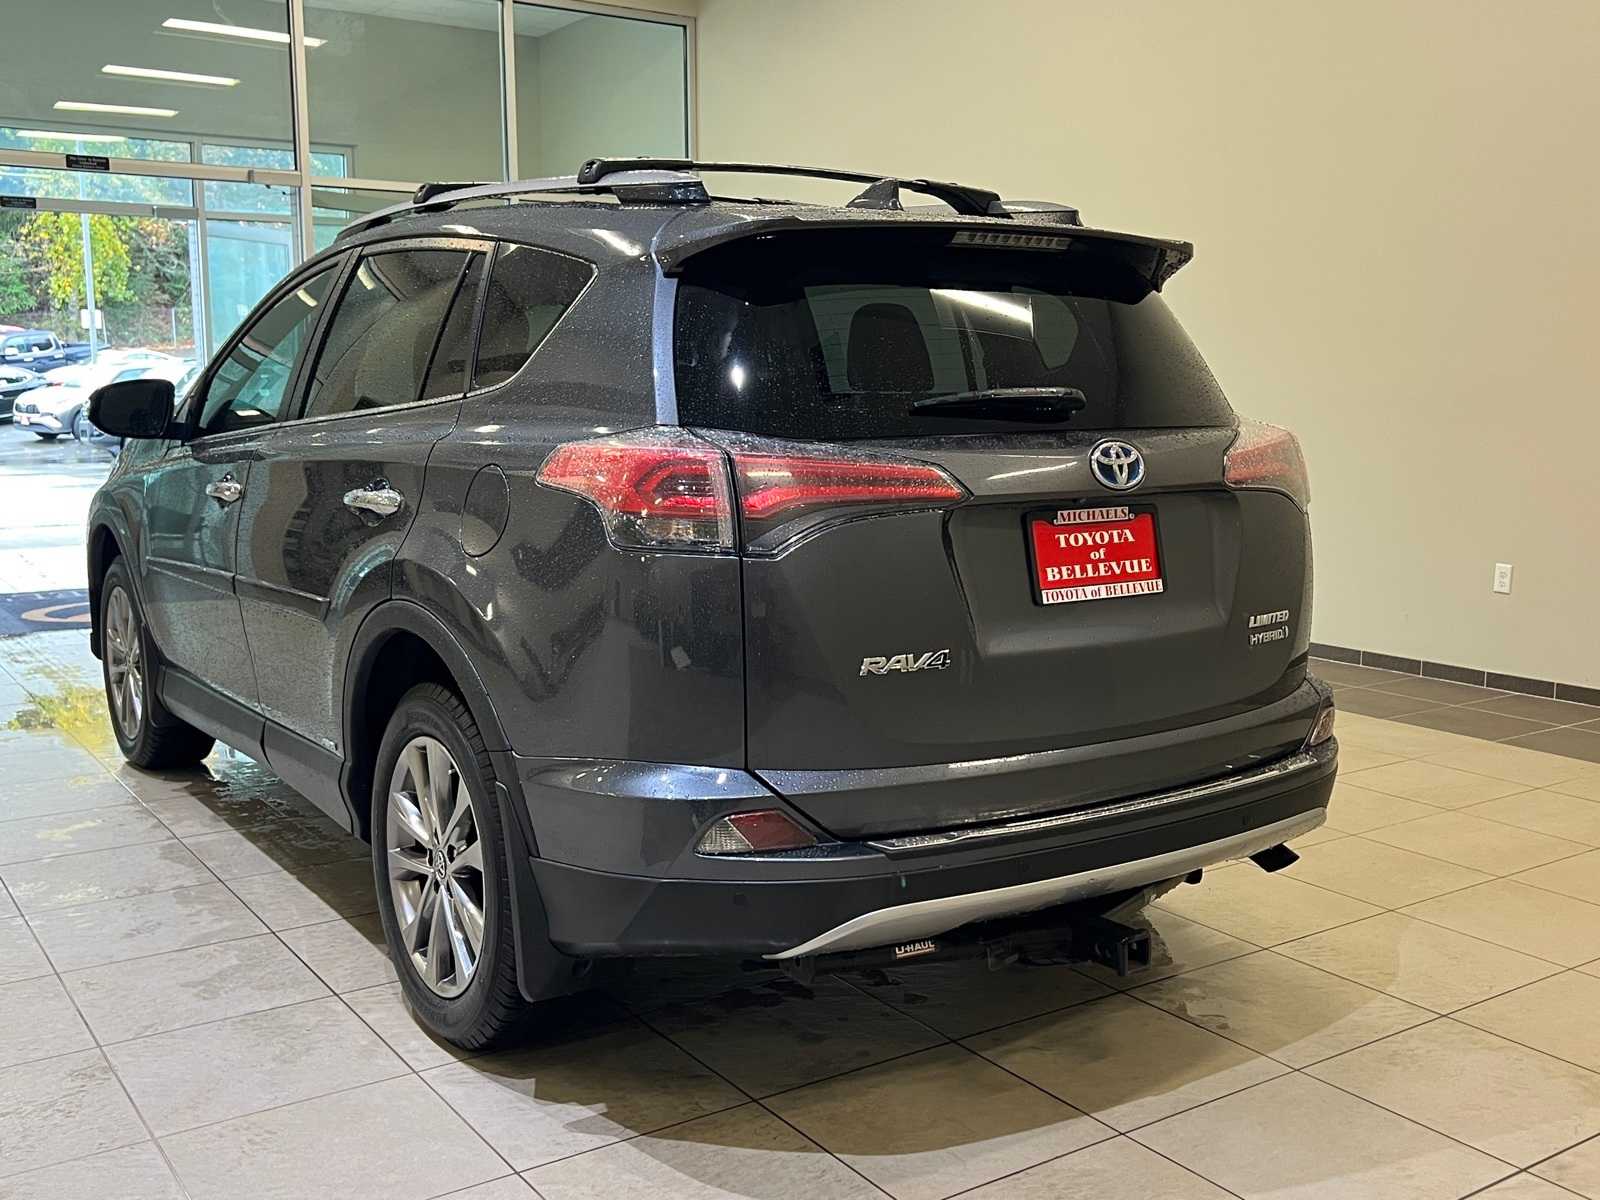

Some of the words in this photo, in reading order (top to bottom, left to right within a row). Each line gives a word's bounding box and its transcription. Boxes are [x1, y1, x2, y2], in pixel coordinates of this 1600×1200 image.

[1059, 508, 1127, 522] MICHAELS
[1055, 529, 1135, 548] TOYOTA
[1090, 548, 1106, 559] of
[1045, 558, 1152, 581] BELLEVUE
[1043, 588, 1088, 602] TOYOTA
[1091, 587, 1103, 599] of
[1105, 580, 1161, 596] BELLEVUE
[1249, 610, 1289, 628] LIMITED
[1250, 629, 1285, 645] HYBRID
[860, 649, 951, 676] RAV4
[895, 940, 935, 954] U-HAUL
